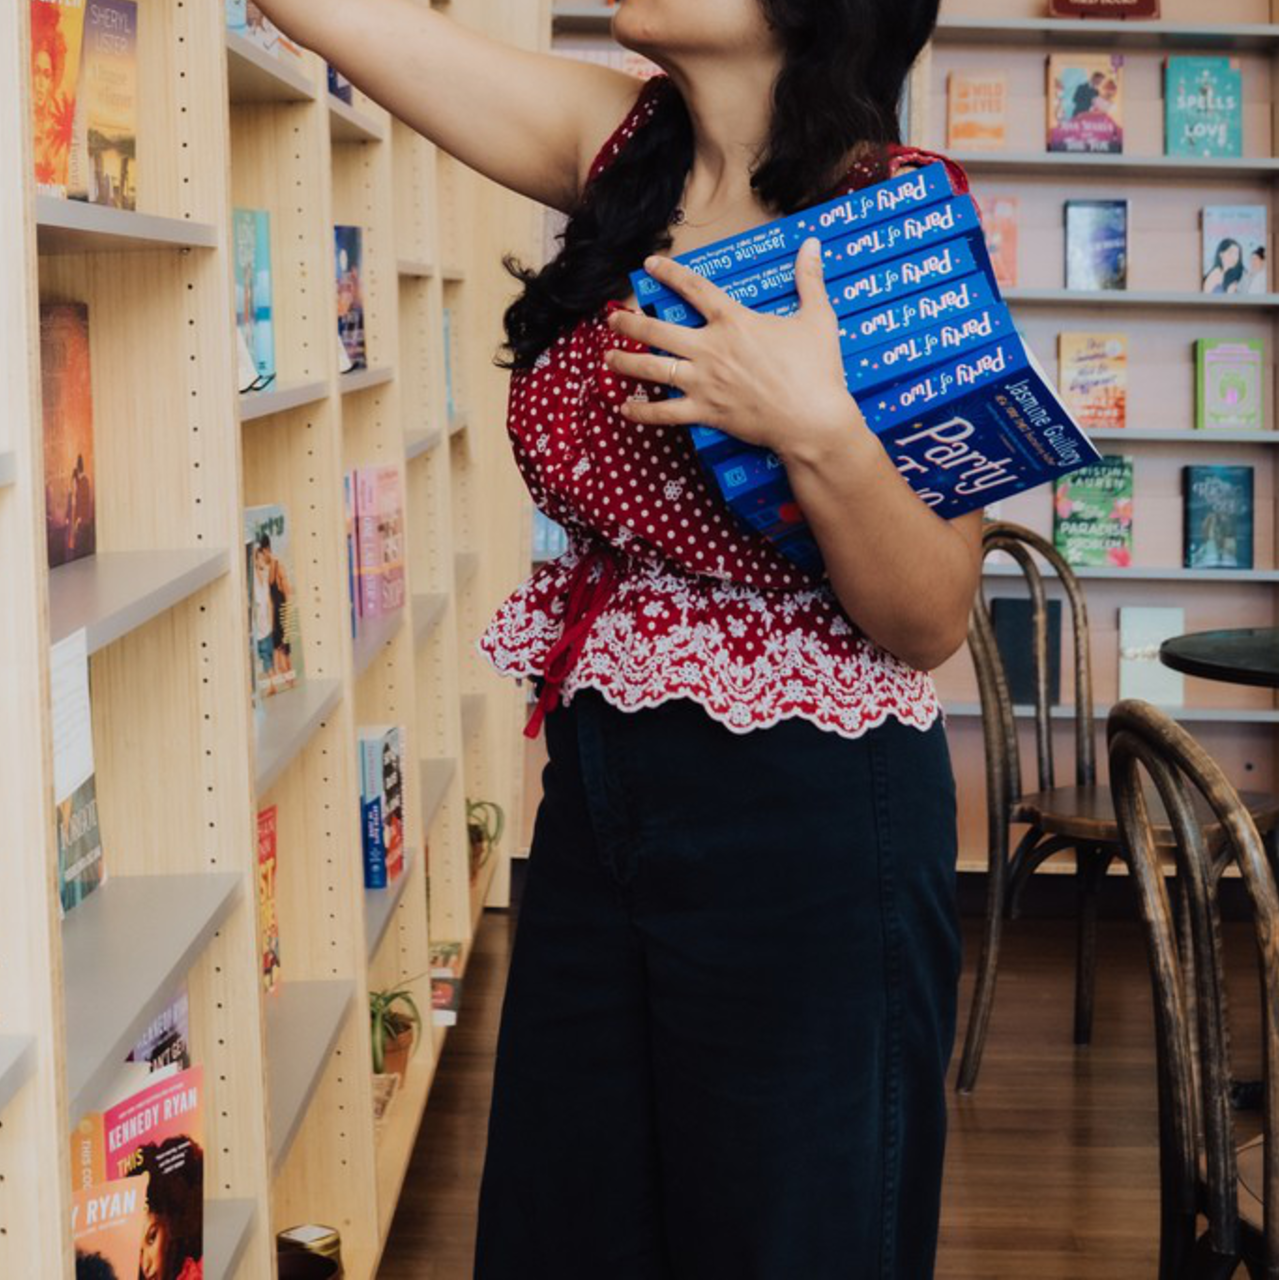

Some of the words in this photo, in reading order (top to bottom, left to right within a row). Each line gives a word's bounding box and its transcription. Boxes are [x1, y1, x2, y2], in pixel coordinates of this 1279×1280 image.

[90, 3, 131, 34] SHERYL
[1177, 95, 1236, 110] SPELLS
[877, 174, 927, 211] Party
[820, 201, 859, 228] Two
[860, 196, 874, 219] of
[904, 204, 955, 240] Party
[735, 233, 786, 261] Jasmine
[846, 230, 886, 257] Two
[887, 225, 901, 248] of
[884, 269, 899, 292] of
[901, 248, 953, 285] Party
[843, 274, 883, 301] Two
[919, 283, 970, 320] Party
[860, 309, 901, 336] Two
[902, 304, 916, 328] of
[940, 311, 993, 349] Party
[882, 338, 923, 366] Two
[924, 333, 939, 357] of
[955, 346, 1007, 386] Party
[899, 378, 939, 407] Two
[939, 372, 954, 396] of
[1005, 379, 1051, 428] Jasmine
[1042, 424, 1084, 468] Guillory
[895, 416, 1020, 496] Party
[1060, 521, 1130, 536] PARADISE
[107, 1106, 160, 1152] KENNEDY
[164, 1087, 198, 1123] RYAN
[116, 1147, 145, 1178] THIS
[85, 1188, 138, 1226] RYAN
